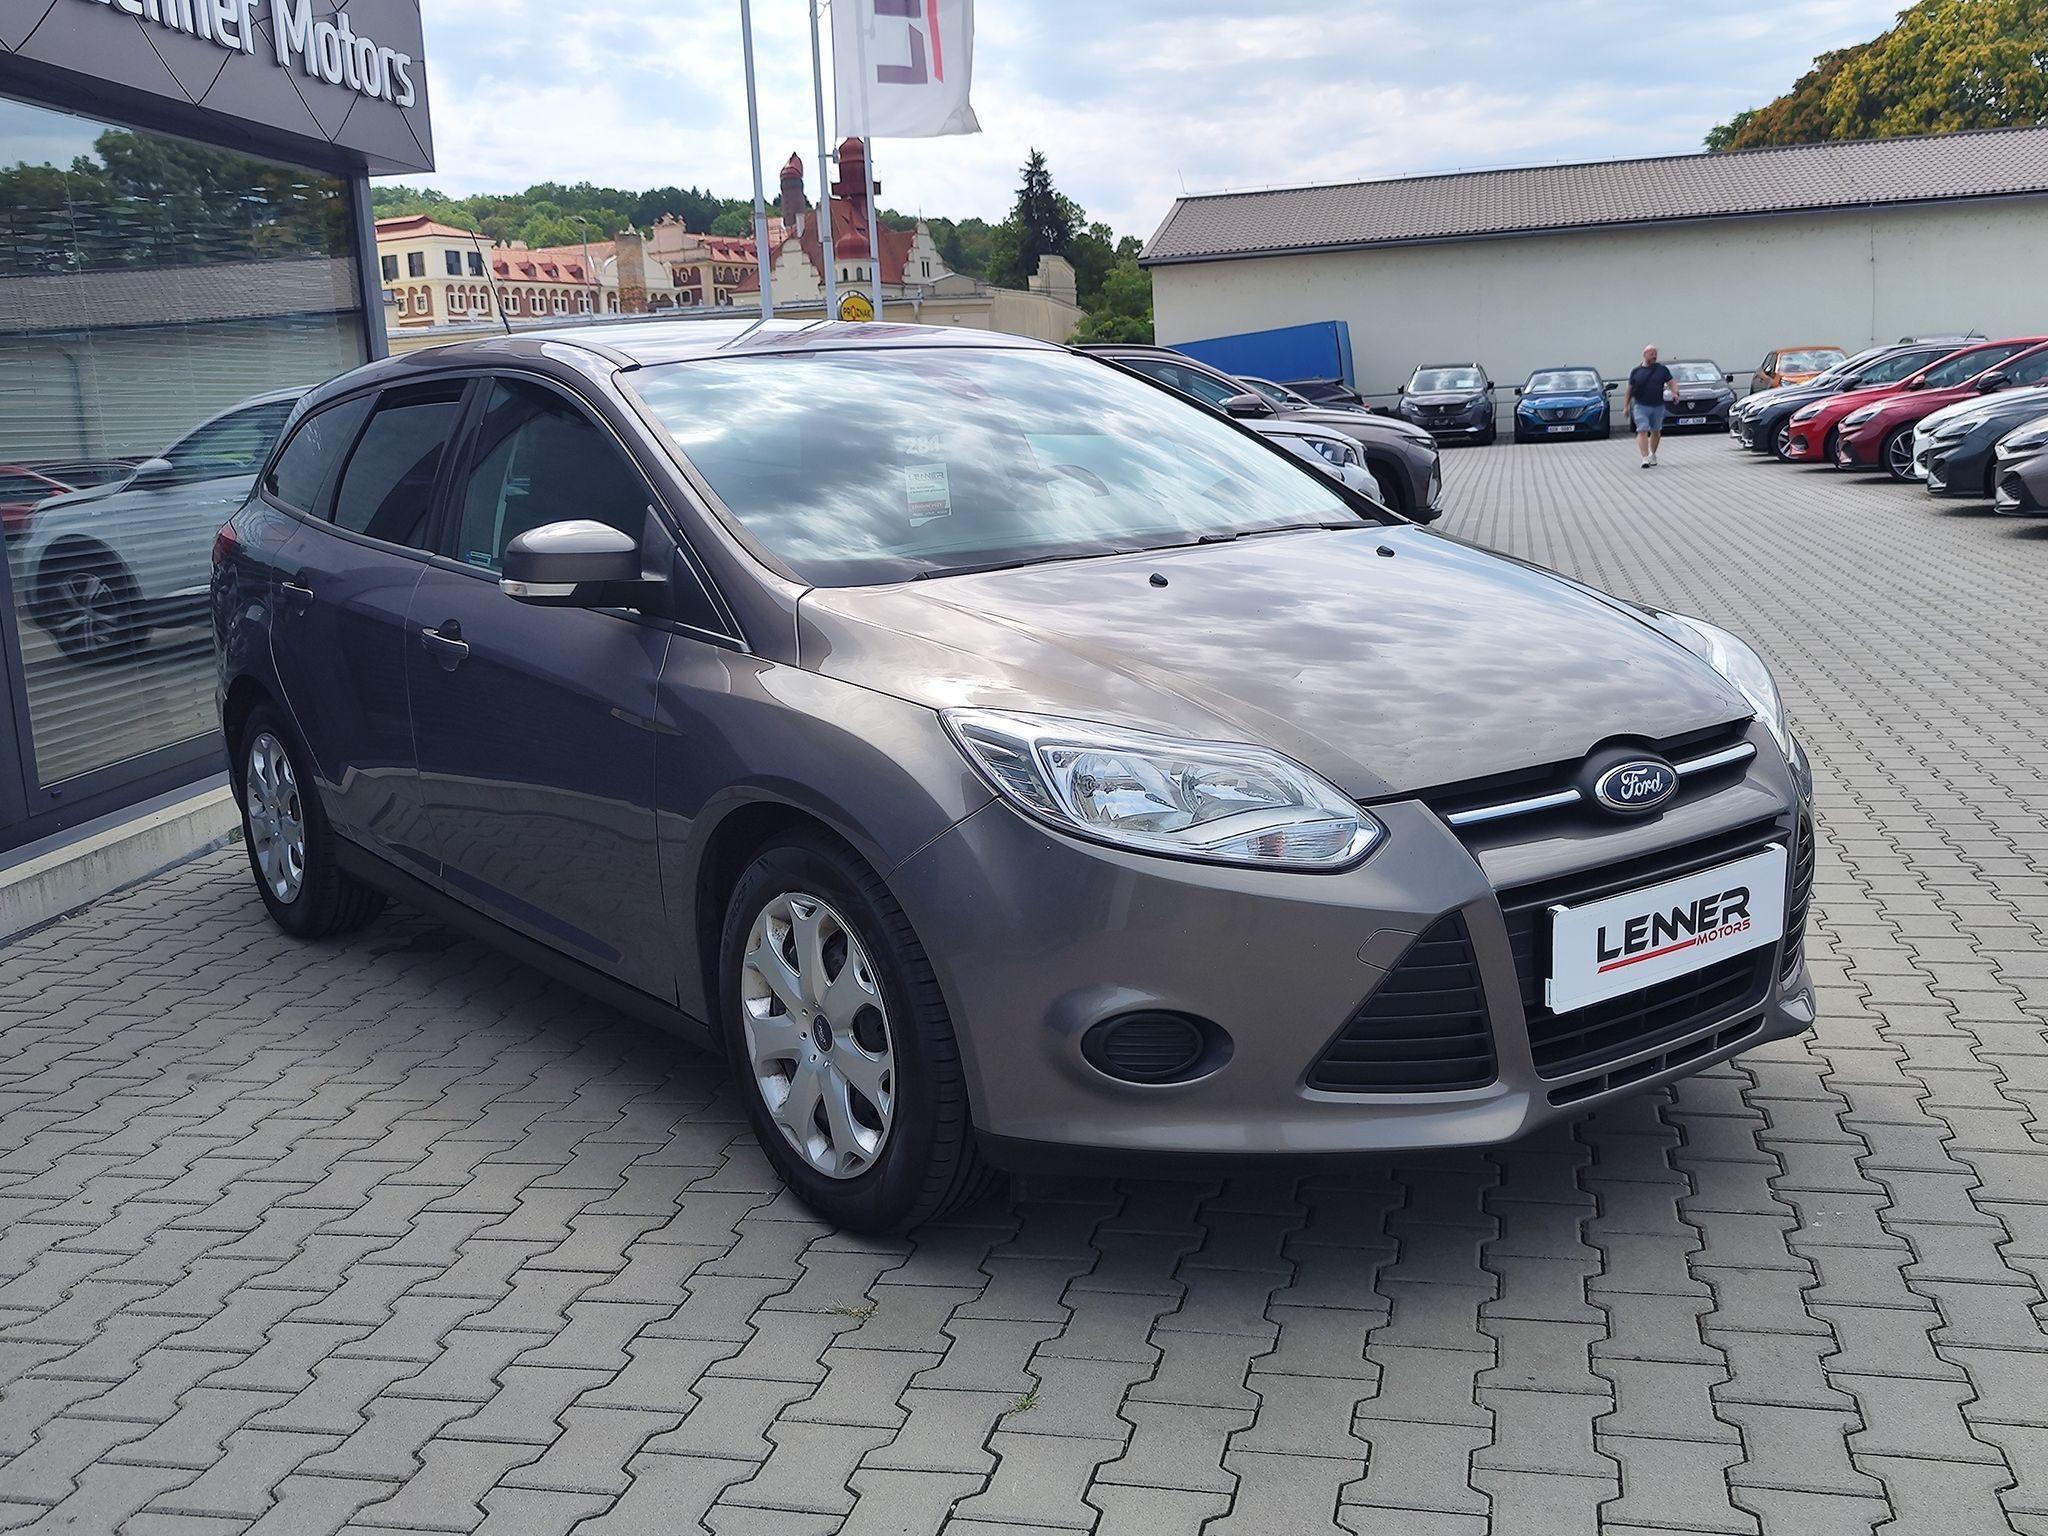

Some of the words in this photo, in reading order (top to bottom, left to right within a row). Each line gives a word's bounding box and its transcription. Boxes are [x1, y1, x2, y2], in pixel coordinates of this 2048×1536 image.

[270, 0, 417, 108] Motors
[1620, 767, 1664, 800] Ford
[1597, 886, 1751, 964] LENNER
[1696, 918, 1751, 946] MOTORS
